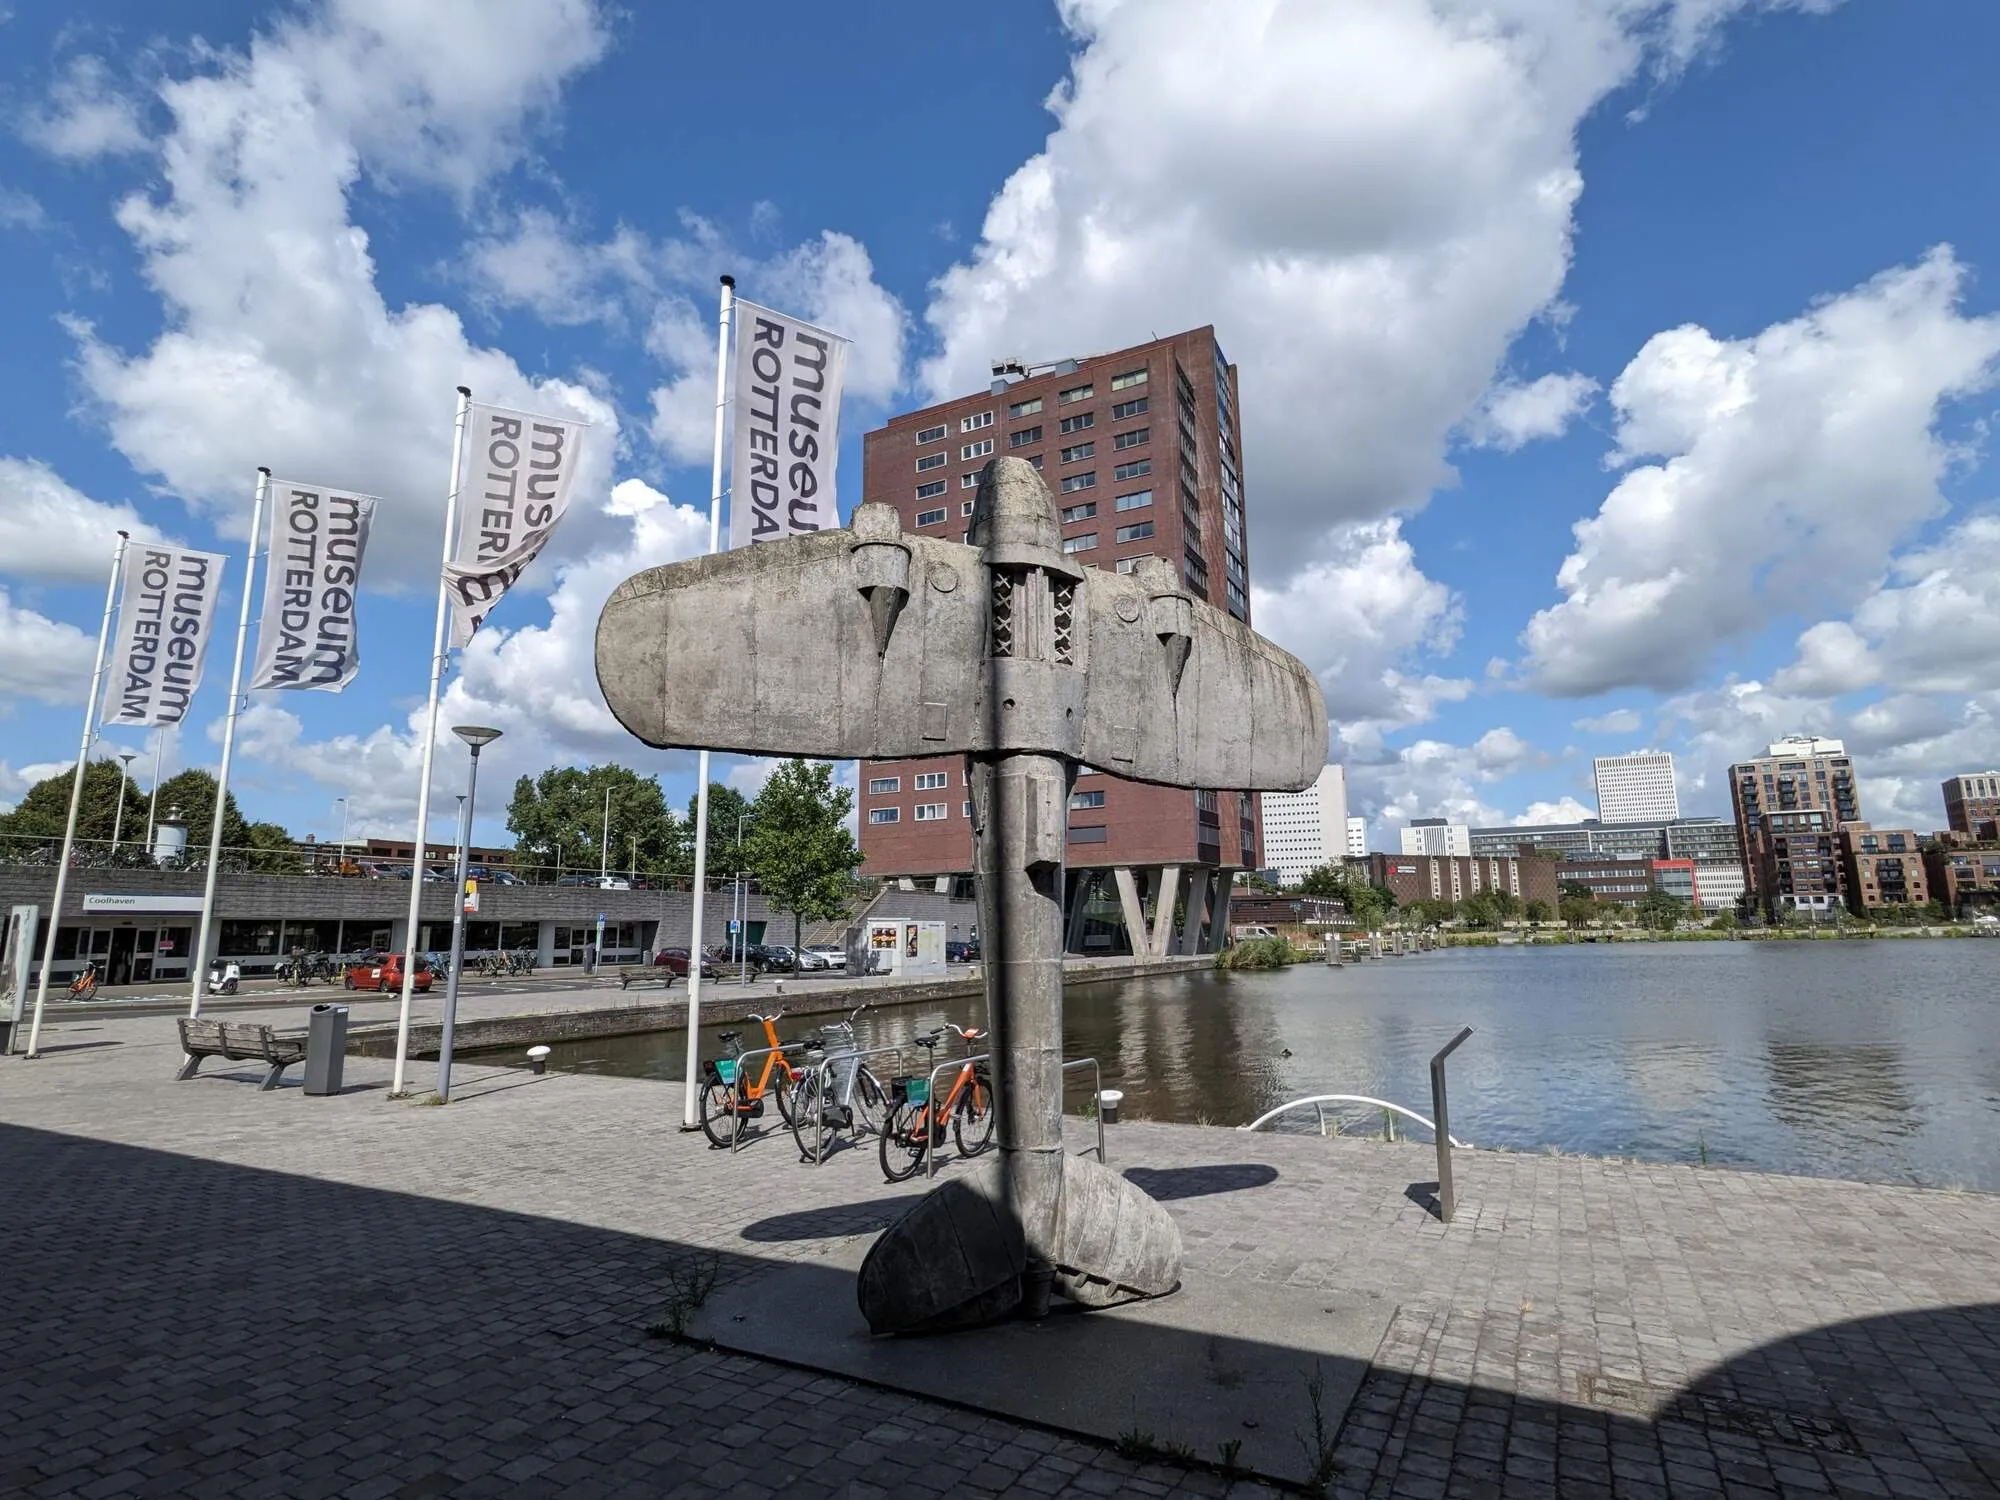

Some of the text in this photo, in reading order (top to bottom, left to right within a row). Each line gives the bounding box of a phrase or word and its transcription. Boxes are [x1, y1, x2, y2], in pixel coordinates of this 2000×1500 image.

[477, 415, 522, 561] ROTTER
[751, 317, 785, 545] ROTTERDA
[788, 332, 828, 537] museu
[120, 550, 171, 719] ROTTERDAM
[156, 555, 209, 723] museum
[271, 489, 319, 682] ROTTERDAM
[311, 496, 360, 684] museum
[89, 897, 136, 905] Coolhaven
